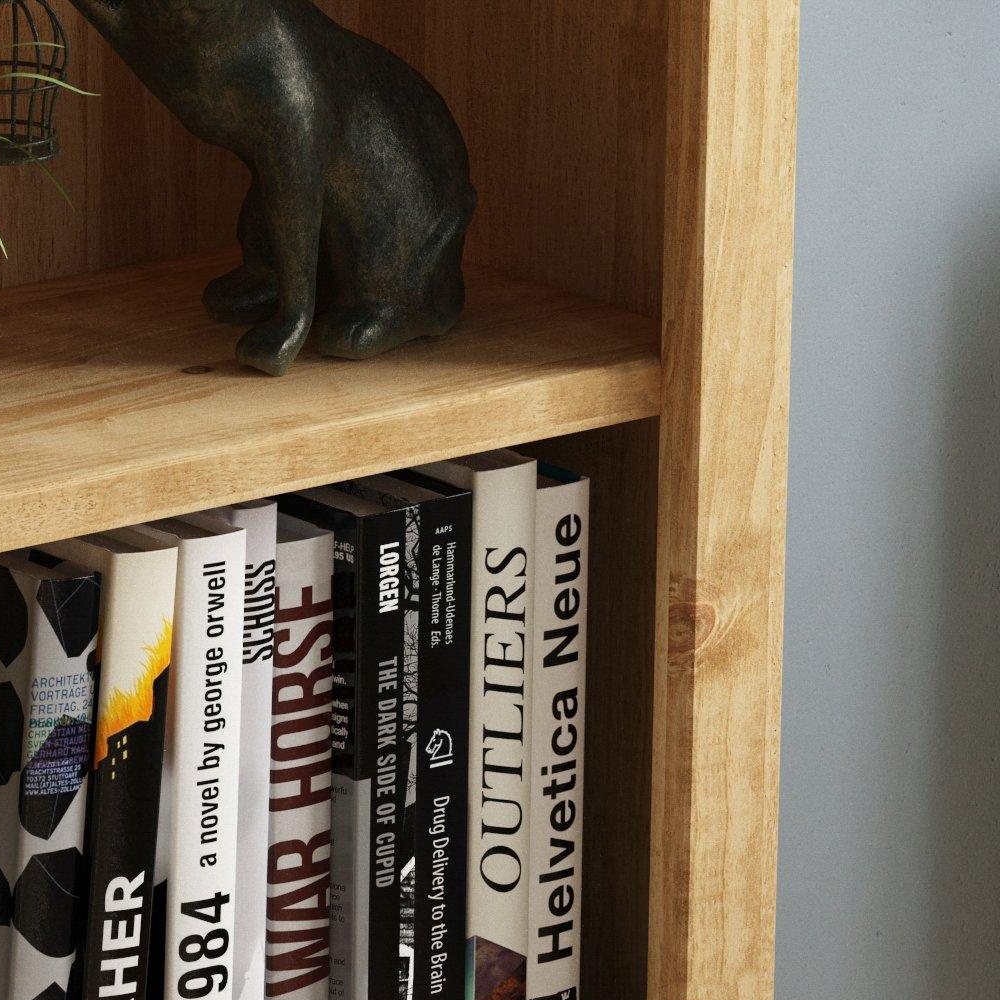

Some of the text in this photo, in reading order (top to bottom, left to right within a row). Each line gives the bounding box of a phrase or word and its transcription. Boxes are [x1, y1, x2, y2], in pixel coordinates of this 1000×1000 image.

[378, 540, 399, 614] LORGEN
[430, 544, 442, 649] de Lange Thorne Eds.
[435, 524, 453, 535] AAPS
[197, 560, 228, 868] a novel by george orwell
[265, 586, 334, 998] WAR HORSE
[375, 656, 398, 889] THE DARK SIDE OF CUPID
[479, 546, 527, 893] OUTLIERS
[537, 513, 581, 964] Helvetica Neue
[428, 795, 450, 995] Drug Delivery to the Brain
